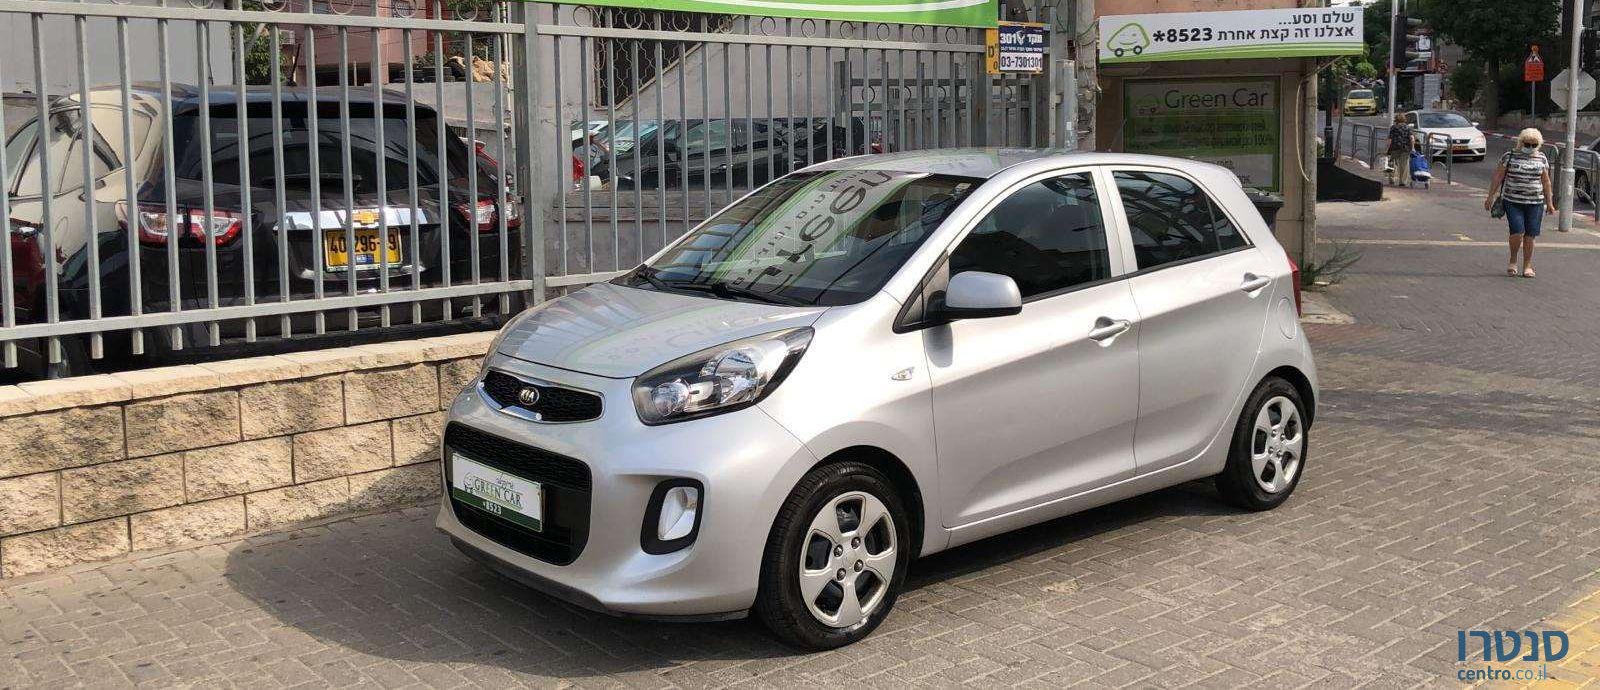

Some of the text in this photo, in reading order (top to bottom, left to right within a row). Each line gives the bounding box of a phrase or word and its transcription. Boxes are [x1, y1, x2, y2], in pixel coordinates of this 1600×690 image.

[1322, 11, 1355, 24] שלם
[1217, 28, 1256, 41] אחרת
[1260, 28, 1290, 42] קצת
[1294, 27, 1310, 38] זה
[1314, 24, 1355, 38] אצלנו
[1000, 33, 1017, 44] 301
[1001, 56, 1043, 68] 03-7301301
[1165, 88, 1269, 109] Green Car
[474, 479, 501, 501] GREEN
[503, 490, 522, 508] CAR
